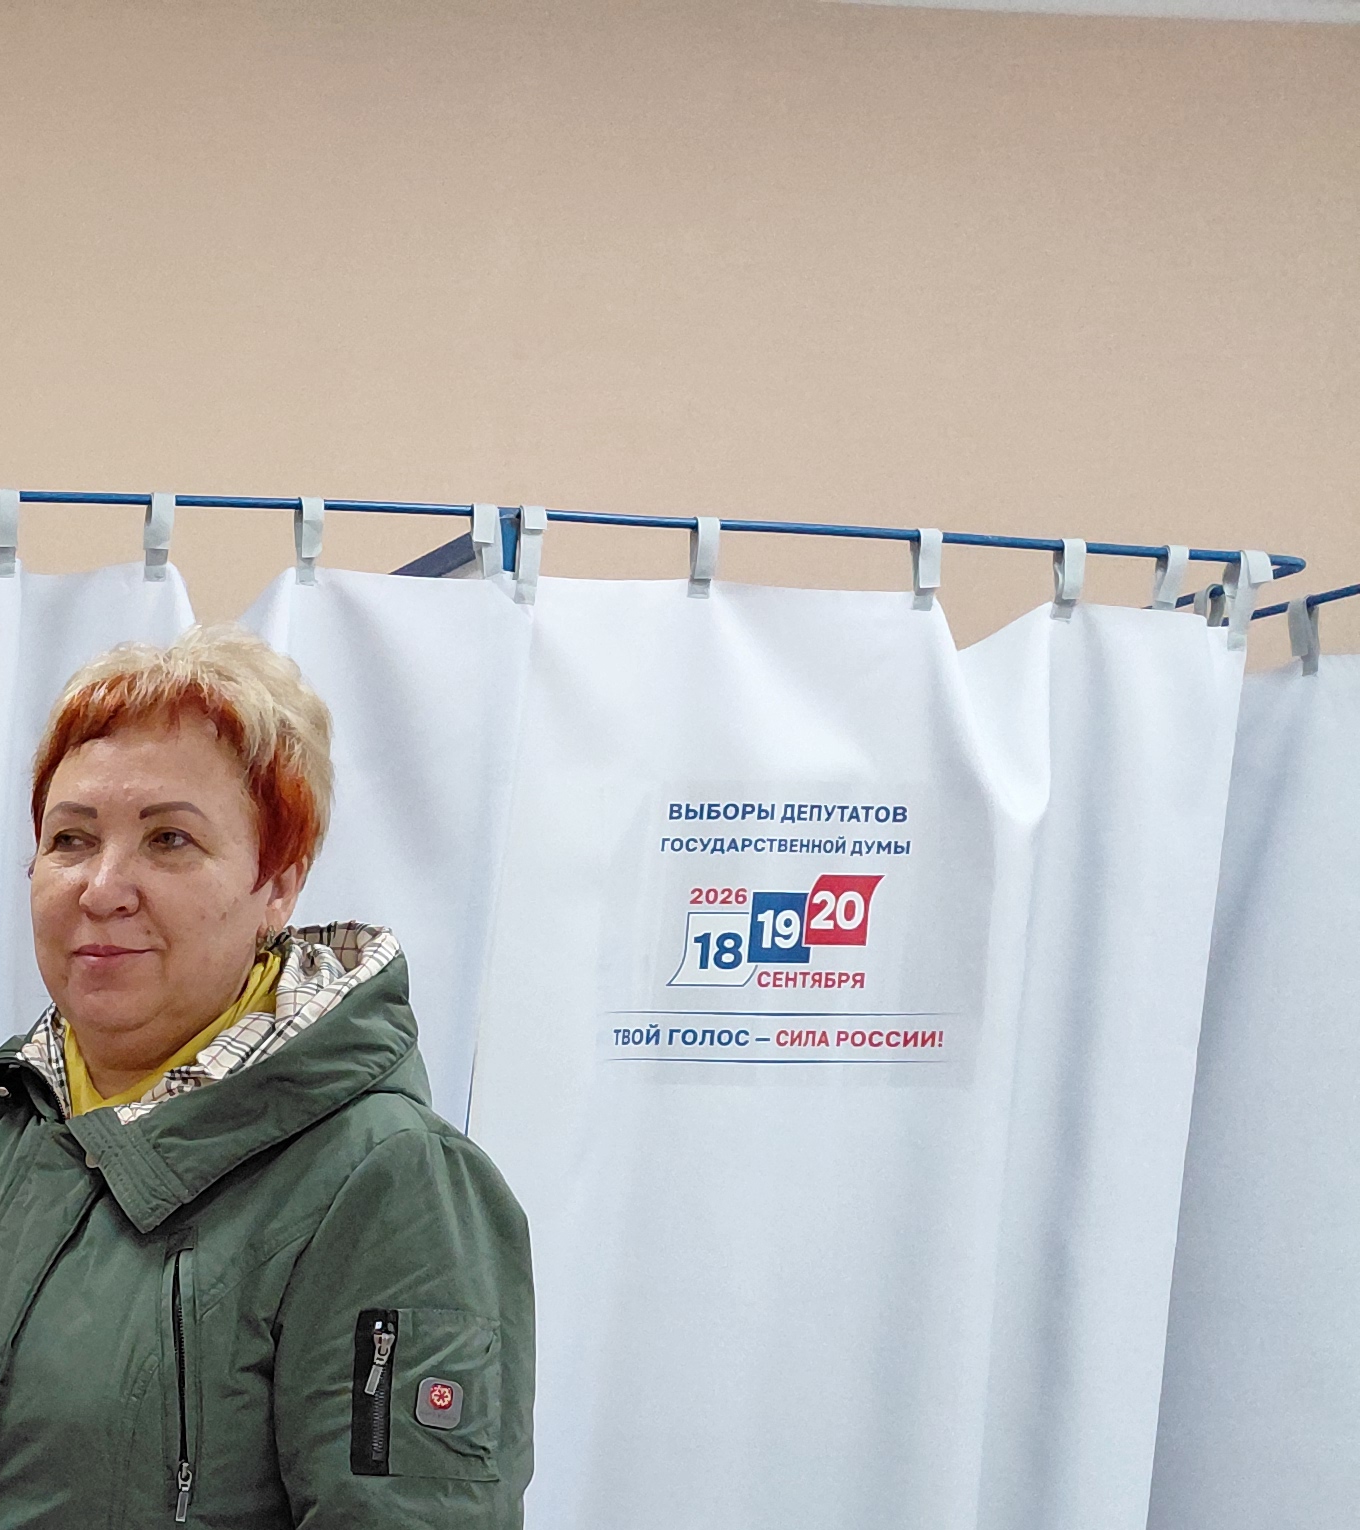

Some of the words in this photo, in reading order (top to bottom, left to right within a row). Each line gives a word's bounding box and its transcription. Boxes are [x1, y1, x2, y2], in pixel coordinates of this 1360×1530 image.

[668, 803, 776, 821] ВЫБОРЫ
[780, 804, 909, 824] ДЕПУТАТОВ
[660, 835, 847, 855] ГОСУДАРСТВЕННОЙ
[850, 839, 912, 856] ДУМЫ
[689, 887, 748, 905] 2026
[693, 931, 743, 970] 18
[757, 909, 801, 949] 19
[809, 890, 865, 930] 20
[756, 971, 866, 989] СЕНТЯБРЯ
[613, 1024, 661, 1046] ТВОЙ
[668, 1029, 750, 1047] ГОЛОС
[775, 1030, 830, 1048] СИЛА
[835, 1030, 944, 1048] РОССИИ!
